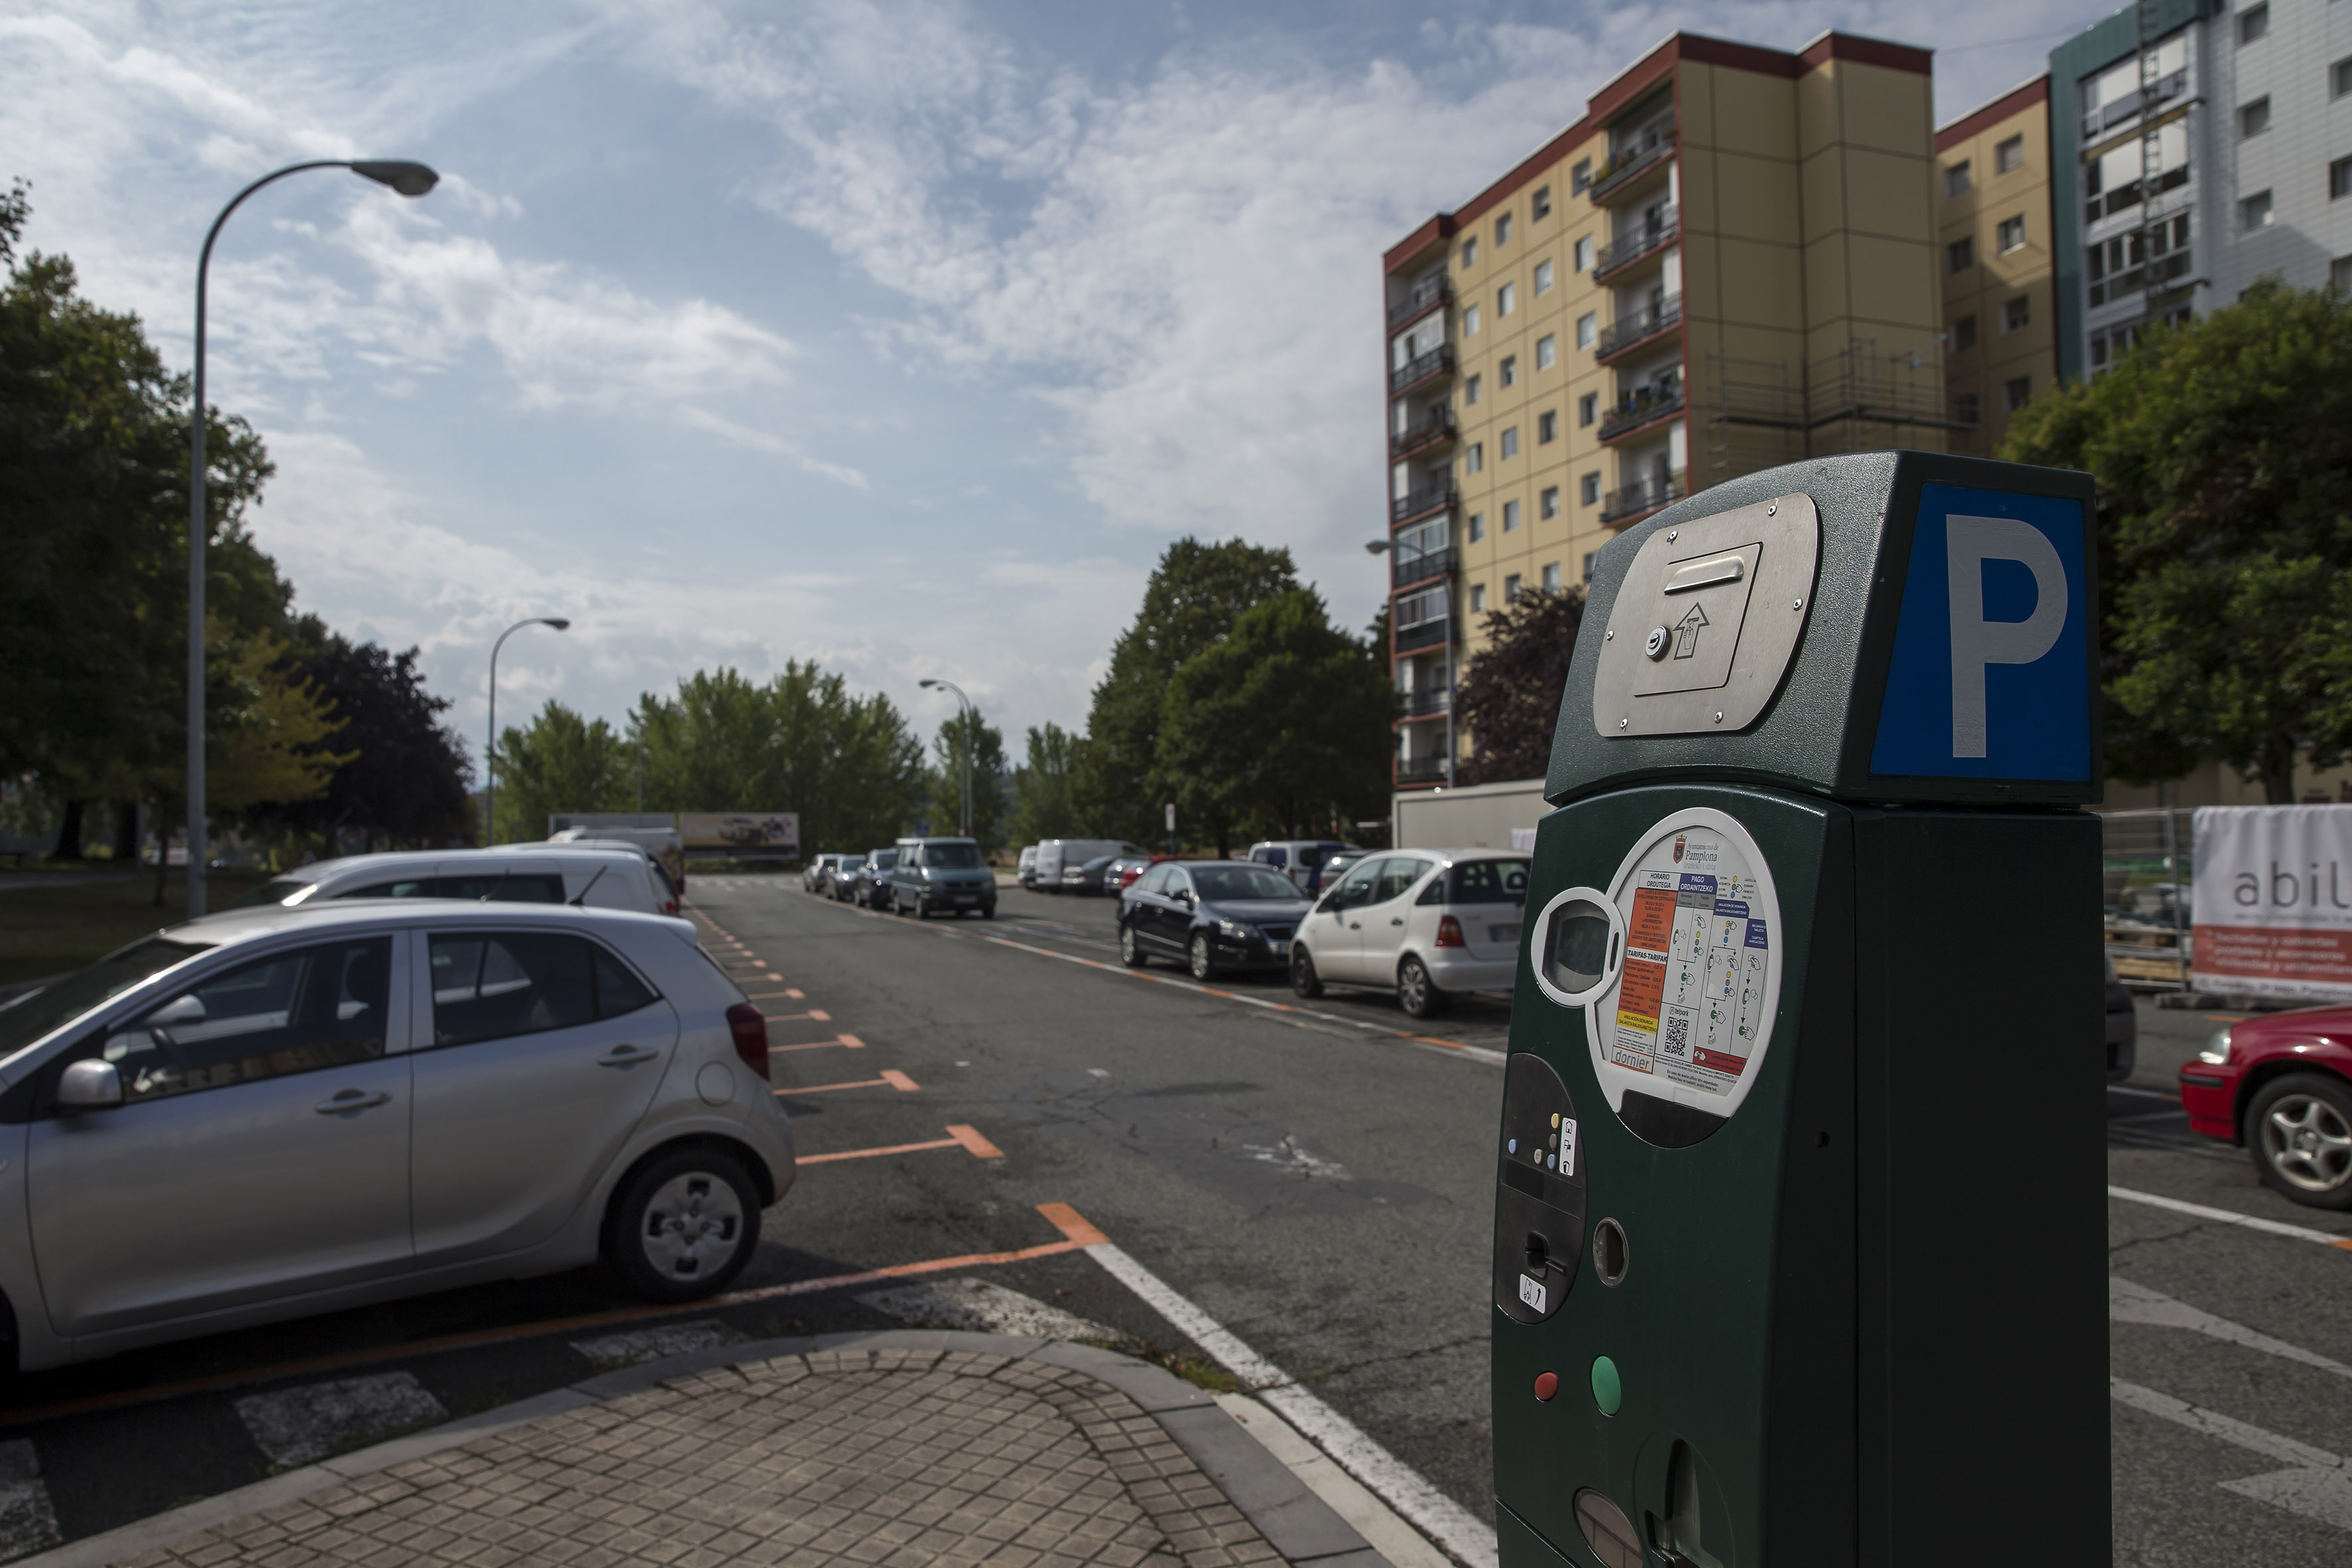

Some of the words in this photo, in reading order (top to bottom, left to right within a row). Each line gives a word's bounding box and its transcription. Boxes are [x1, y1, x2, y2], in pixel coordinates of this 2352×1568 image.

[1946, 514, 2068, 757] P
[1686, 850, 1717, 863] Pamplona
[1628, 950, 1667, 962] TARIFAS-TARIFAK
[1674, 1008, 1689, 1016] telpark
[1616, 1050, 1650, 1069] dornier
